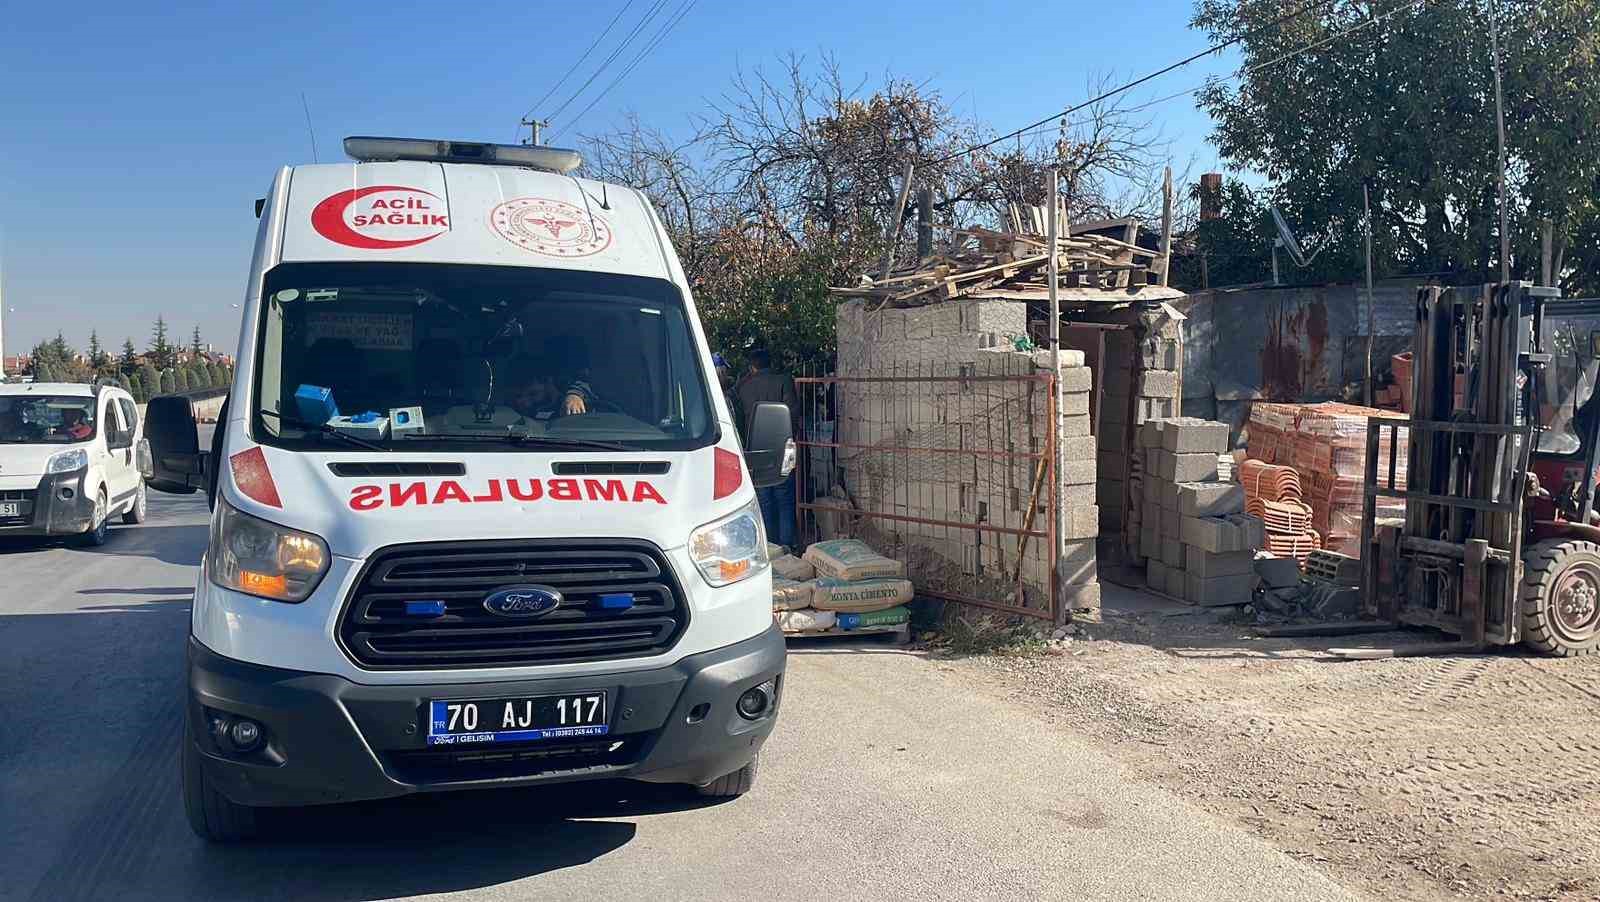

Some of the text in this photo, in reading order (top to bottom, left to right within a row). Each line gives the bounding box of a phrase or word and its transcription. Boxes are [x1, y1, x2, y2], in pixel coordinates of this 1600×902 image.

[371, 196, 430, 209] ACİL
[353, 211, 449, 227] SAĞLIK
[501, 594, 544, 611] Ford
[447, 696, 600, 731] 70 AJ 117
[433, 720, 446, 729] TR
